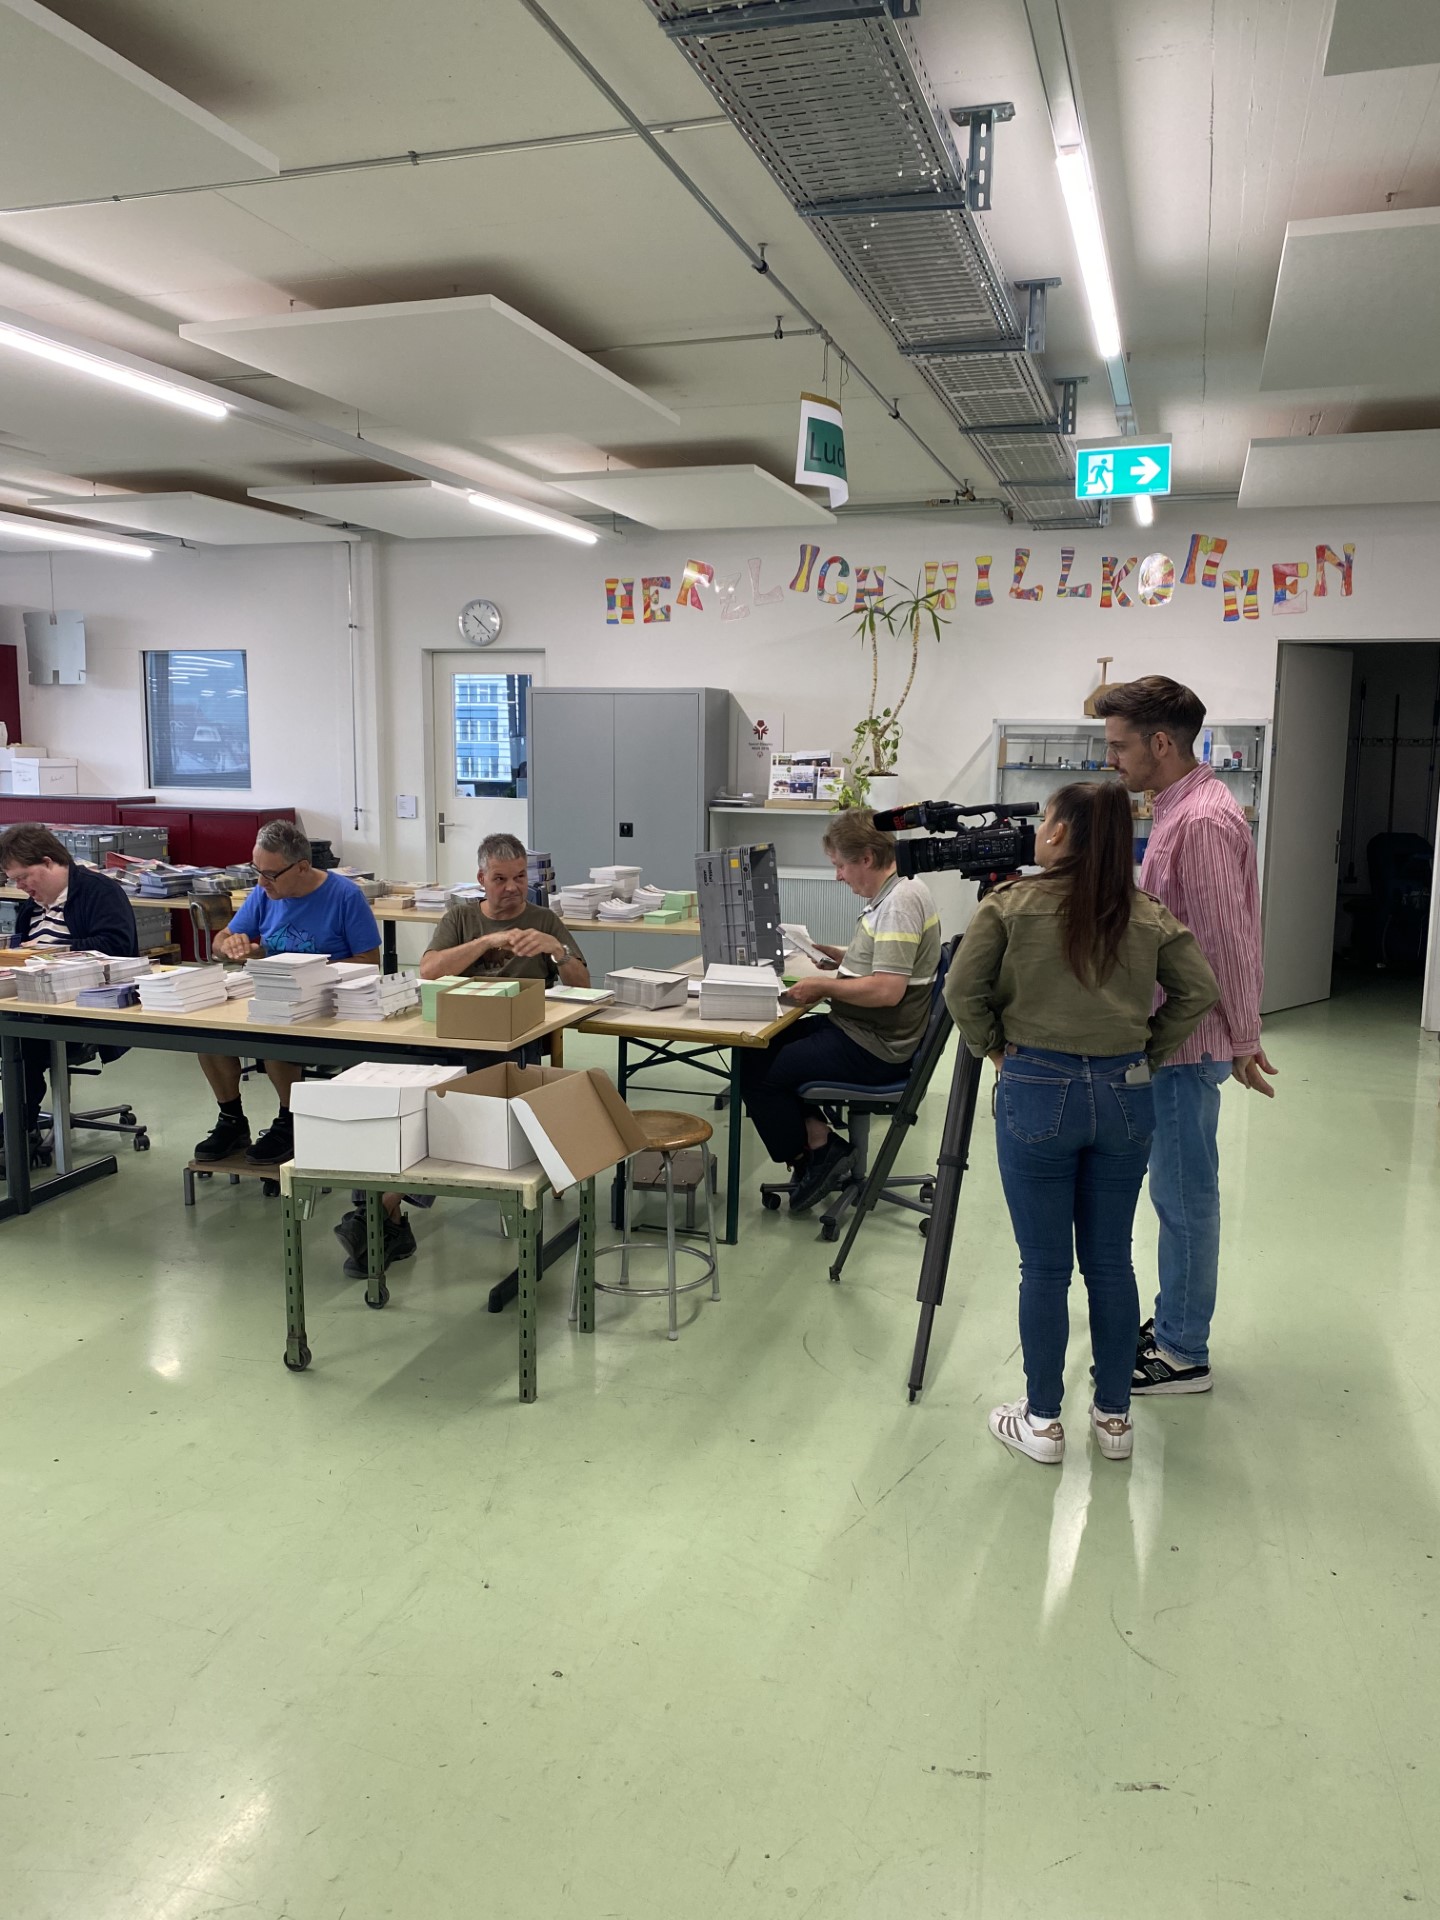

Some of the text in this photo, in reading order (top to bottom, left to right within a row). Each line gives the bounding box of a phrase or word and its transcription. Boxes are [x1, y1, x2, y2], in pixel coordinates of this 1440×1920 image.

[604, 534, 1355, 624] HERZLICH WILLKOMMEN
[1143, 1361, 1171, 1381] N
